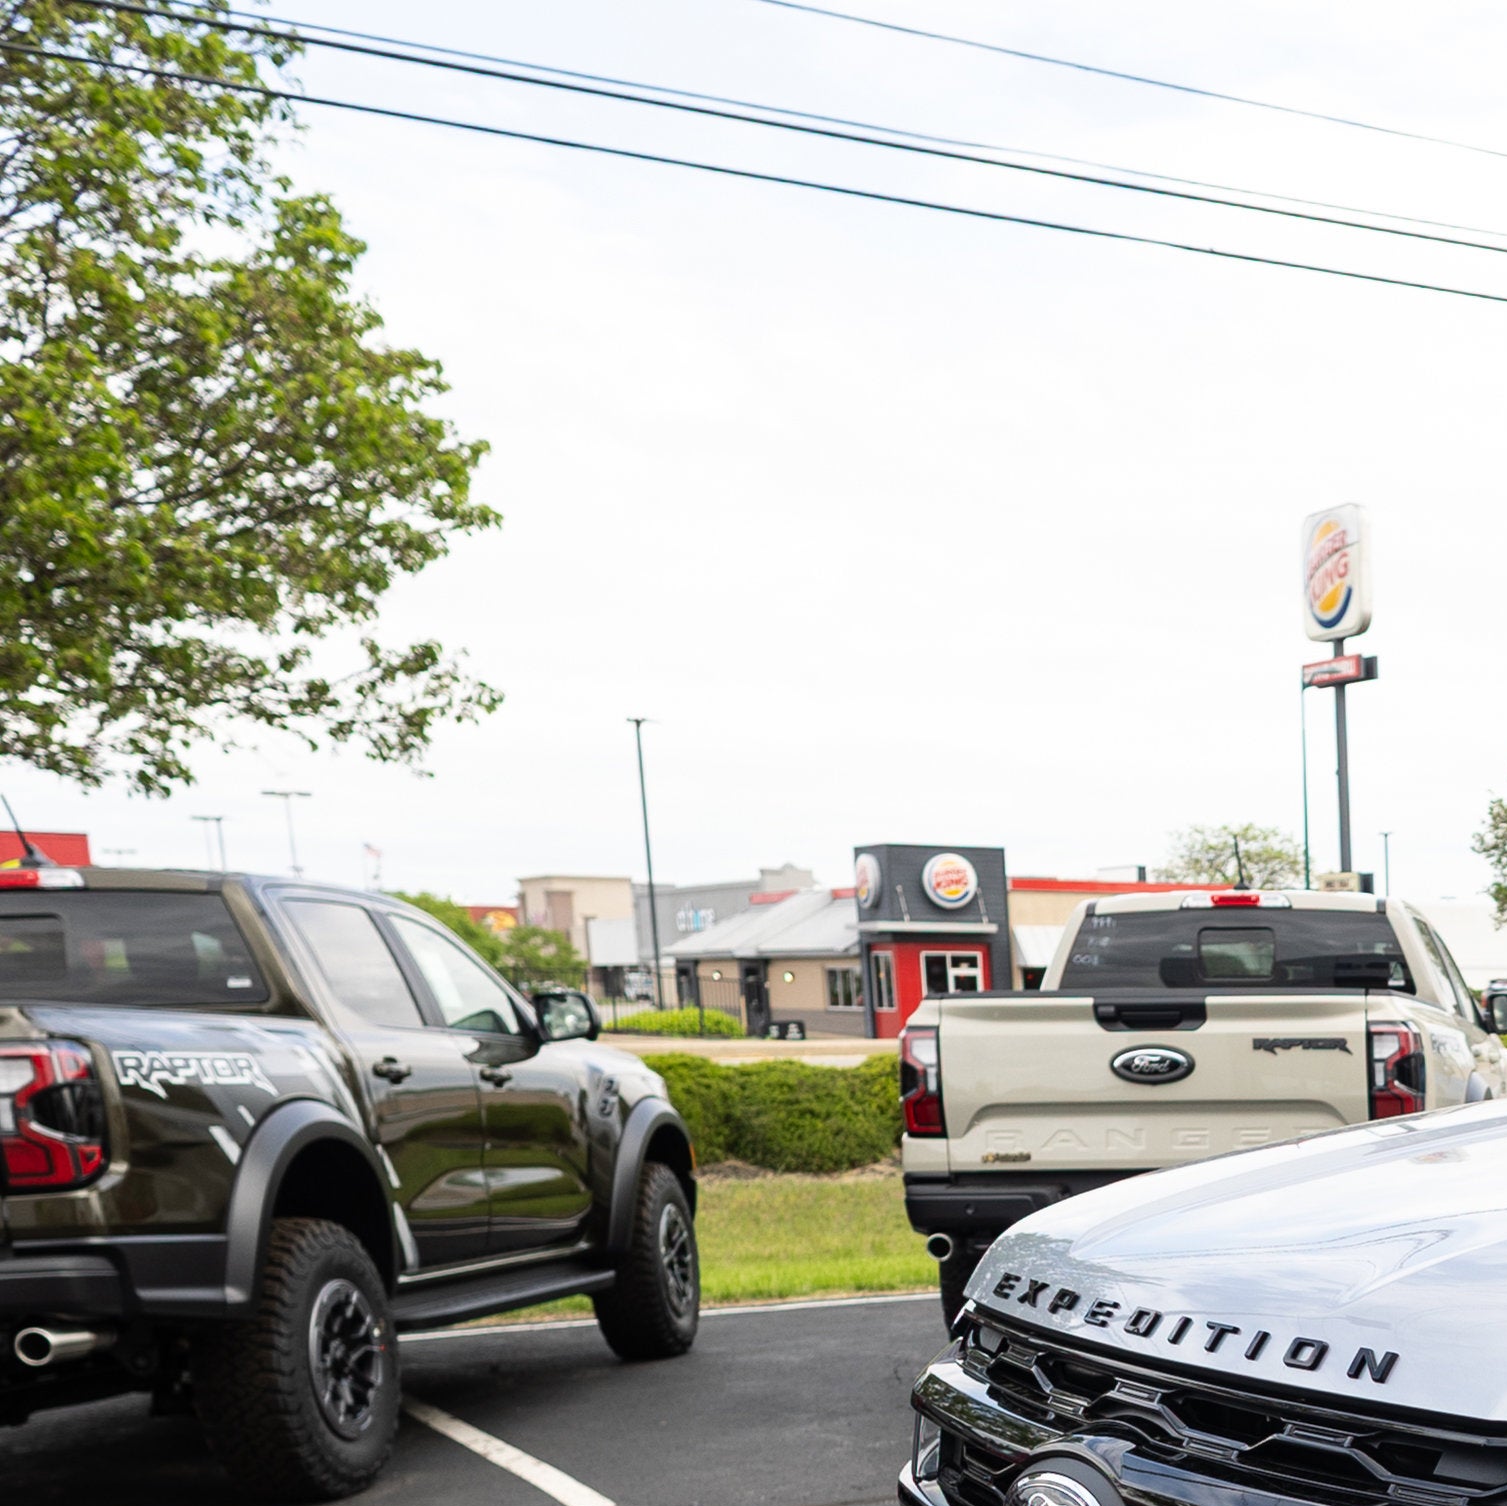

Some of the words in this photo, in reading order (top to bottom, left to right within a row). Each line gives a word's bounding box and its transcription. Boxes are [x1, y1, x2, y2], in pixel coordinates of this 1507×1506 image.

[1252, 1037, 1353, 1055] RAPTOR
[111, 1049, 280, 1100] RAPTOR
[1130, 1054, 1172, 1074] Ford
[991, 1271, 1400, 1384] EXPEDITION
